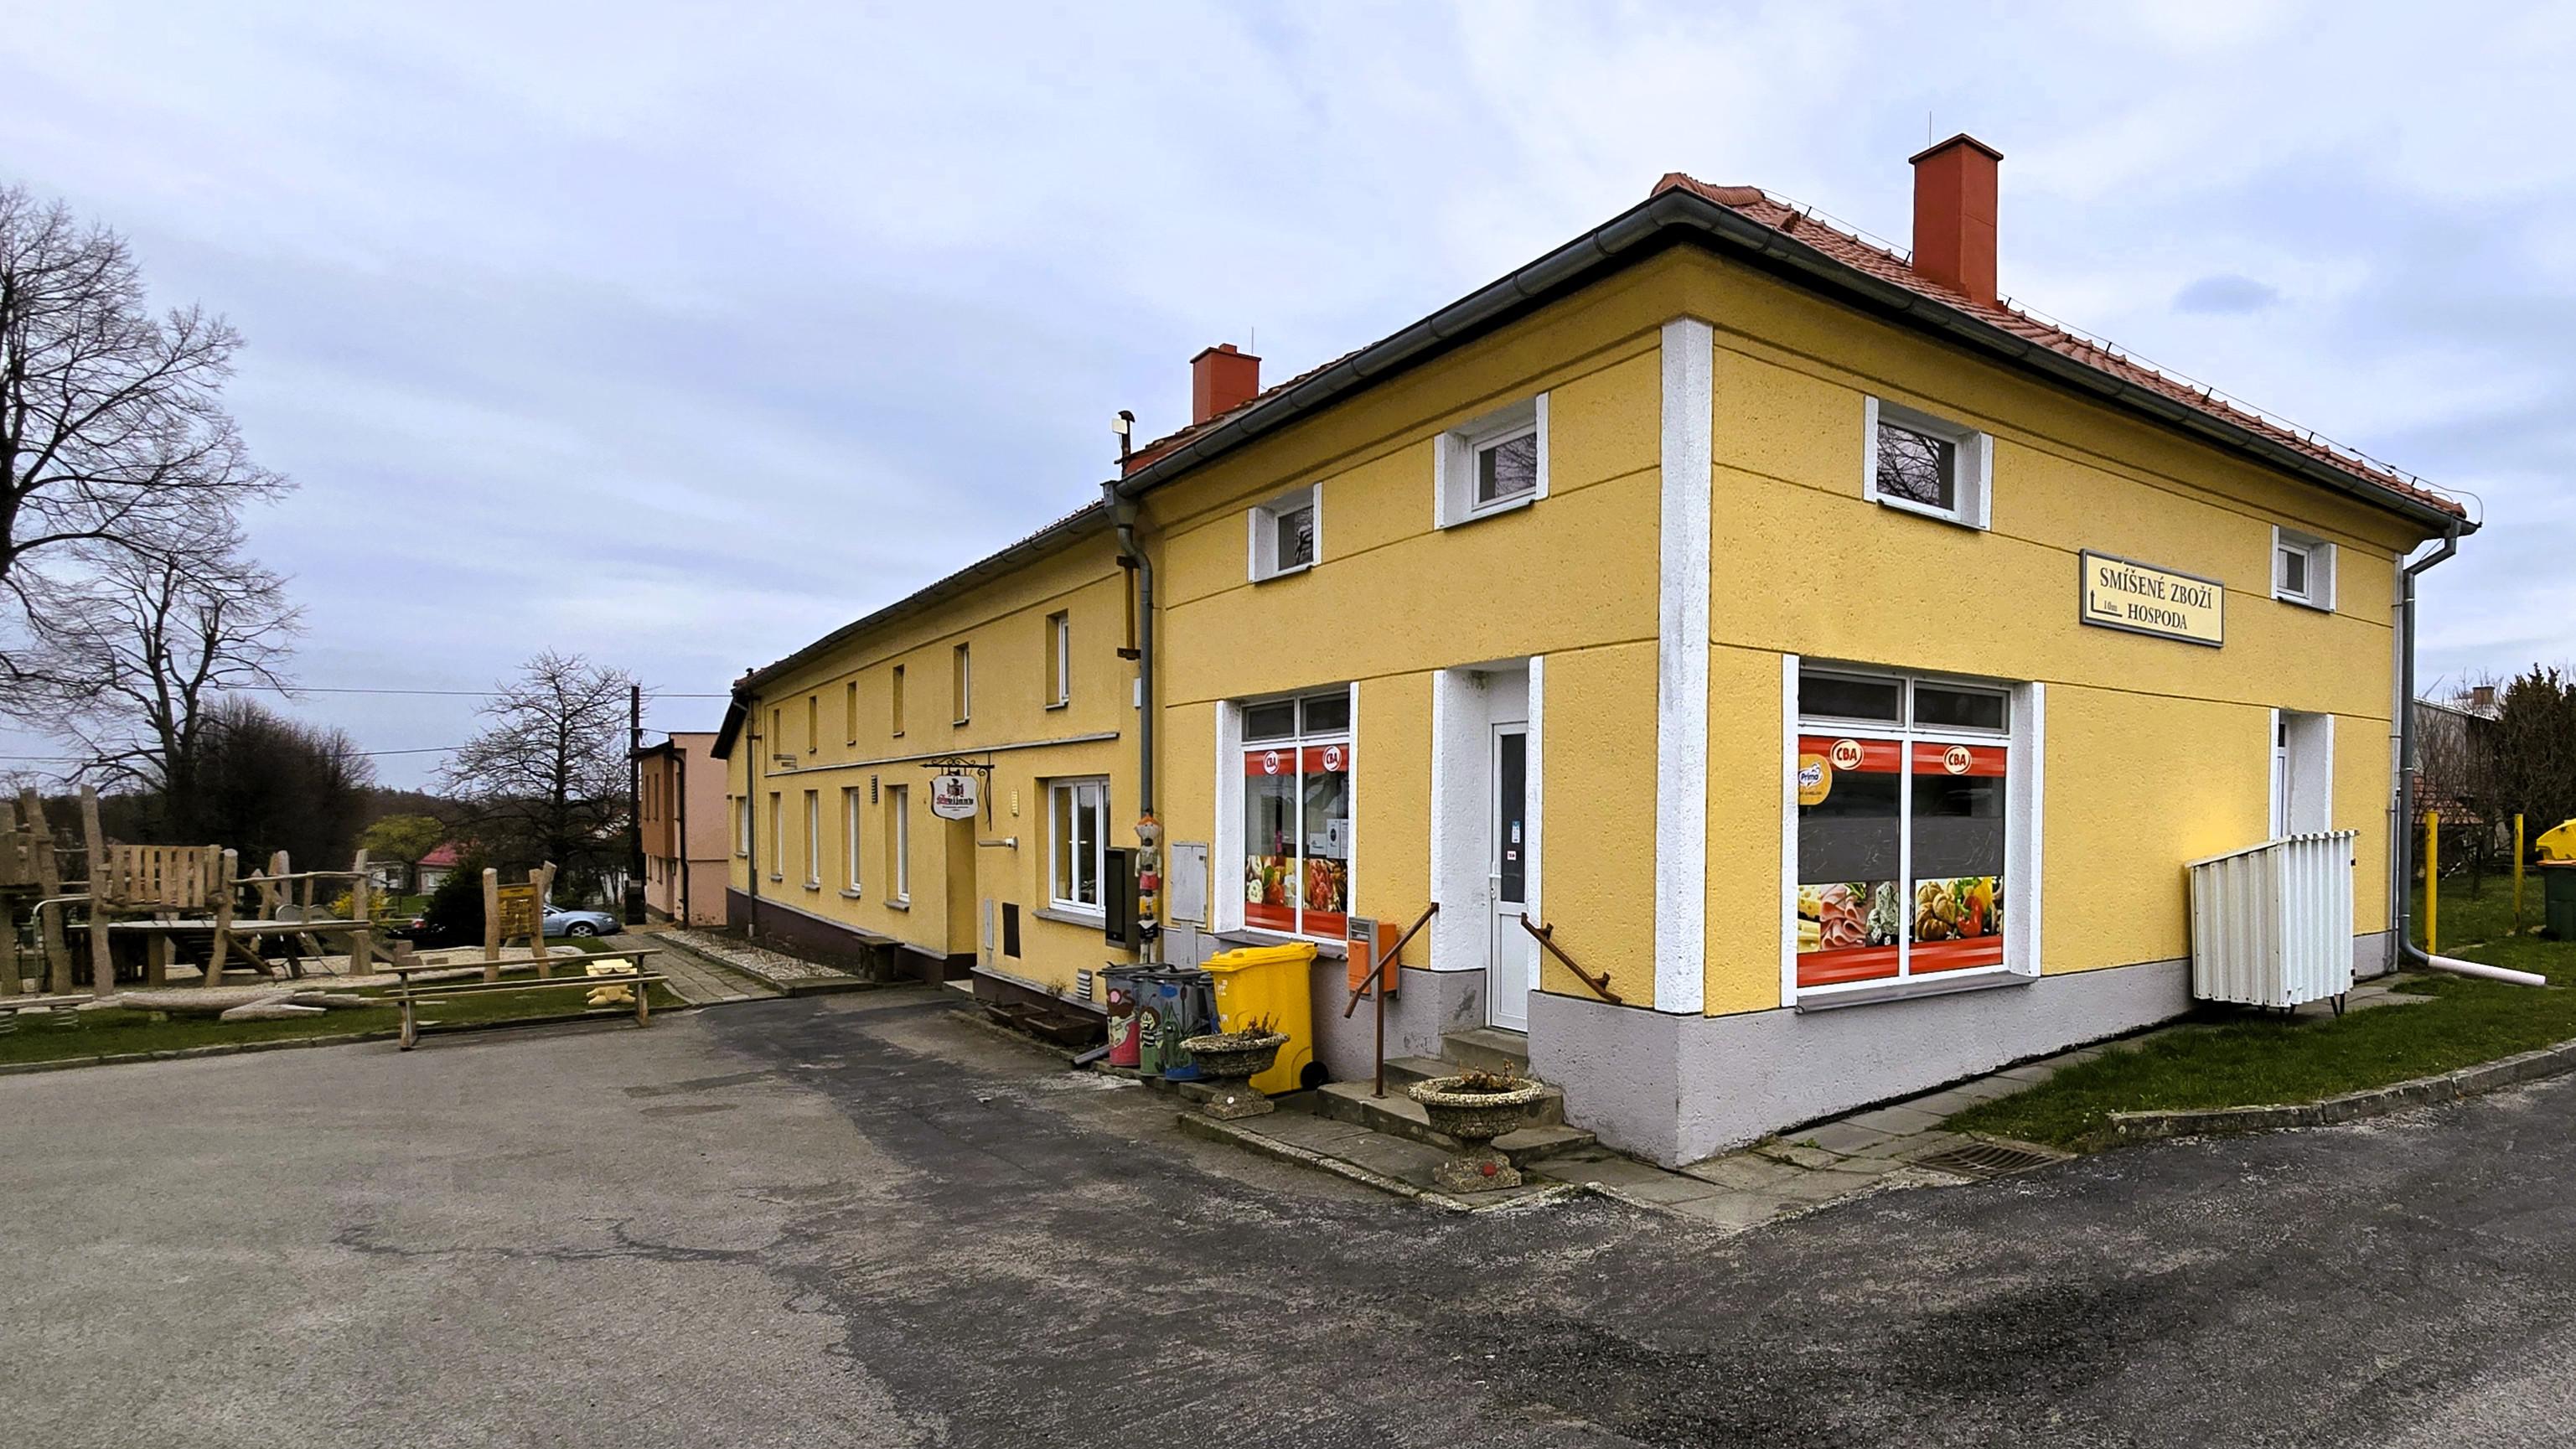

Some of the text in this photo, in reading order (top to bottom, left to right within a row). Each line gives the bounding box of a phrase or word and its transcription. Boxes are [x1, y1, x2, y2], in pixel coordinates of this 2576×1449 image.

[2100, 567, 2212, 609] SMÍŠENÉ ZBOŽÍ
[2128, 603, 2187, 629] HOSPODA
[1327, 753, 1338, 764] CBA
[1836, 748, 1857, 761] CBA
[1948, 753, 1966, 766] CBA
[1266, 757, 1276, 768] CBA
